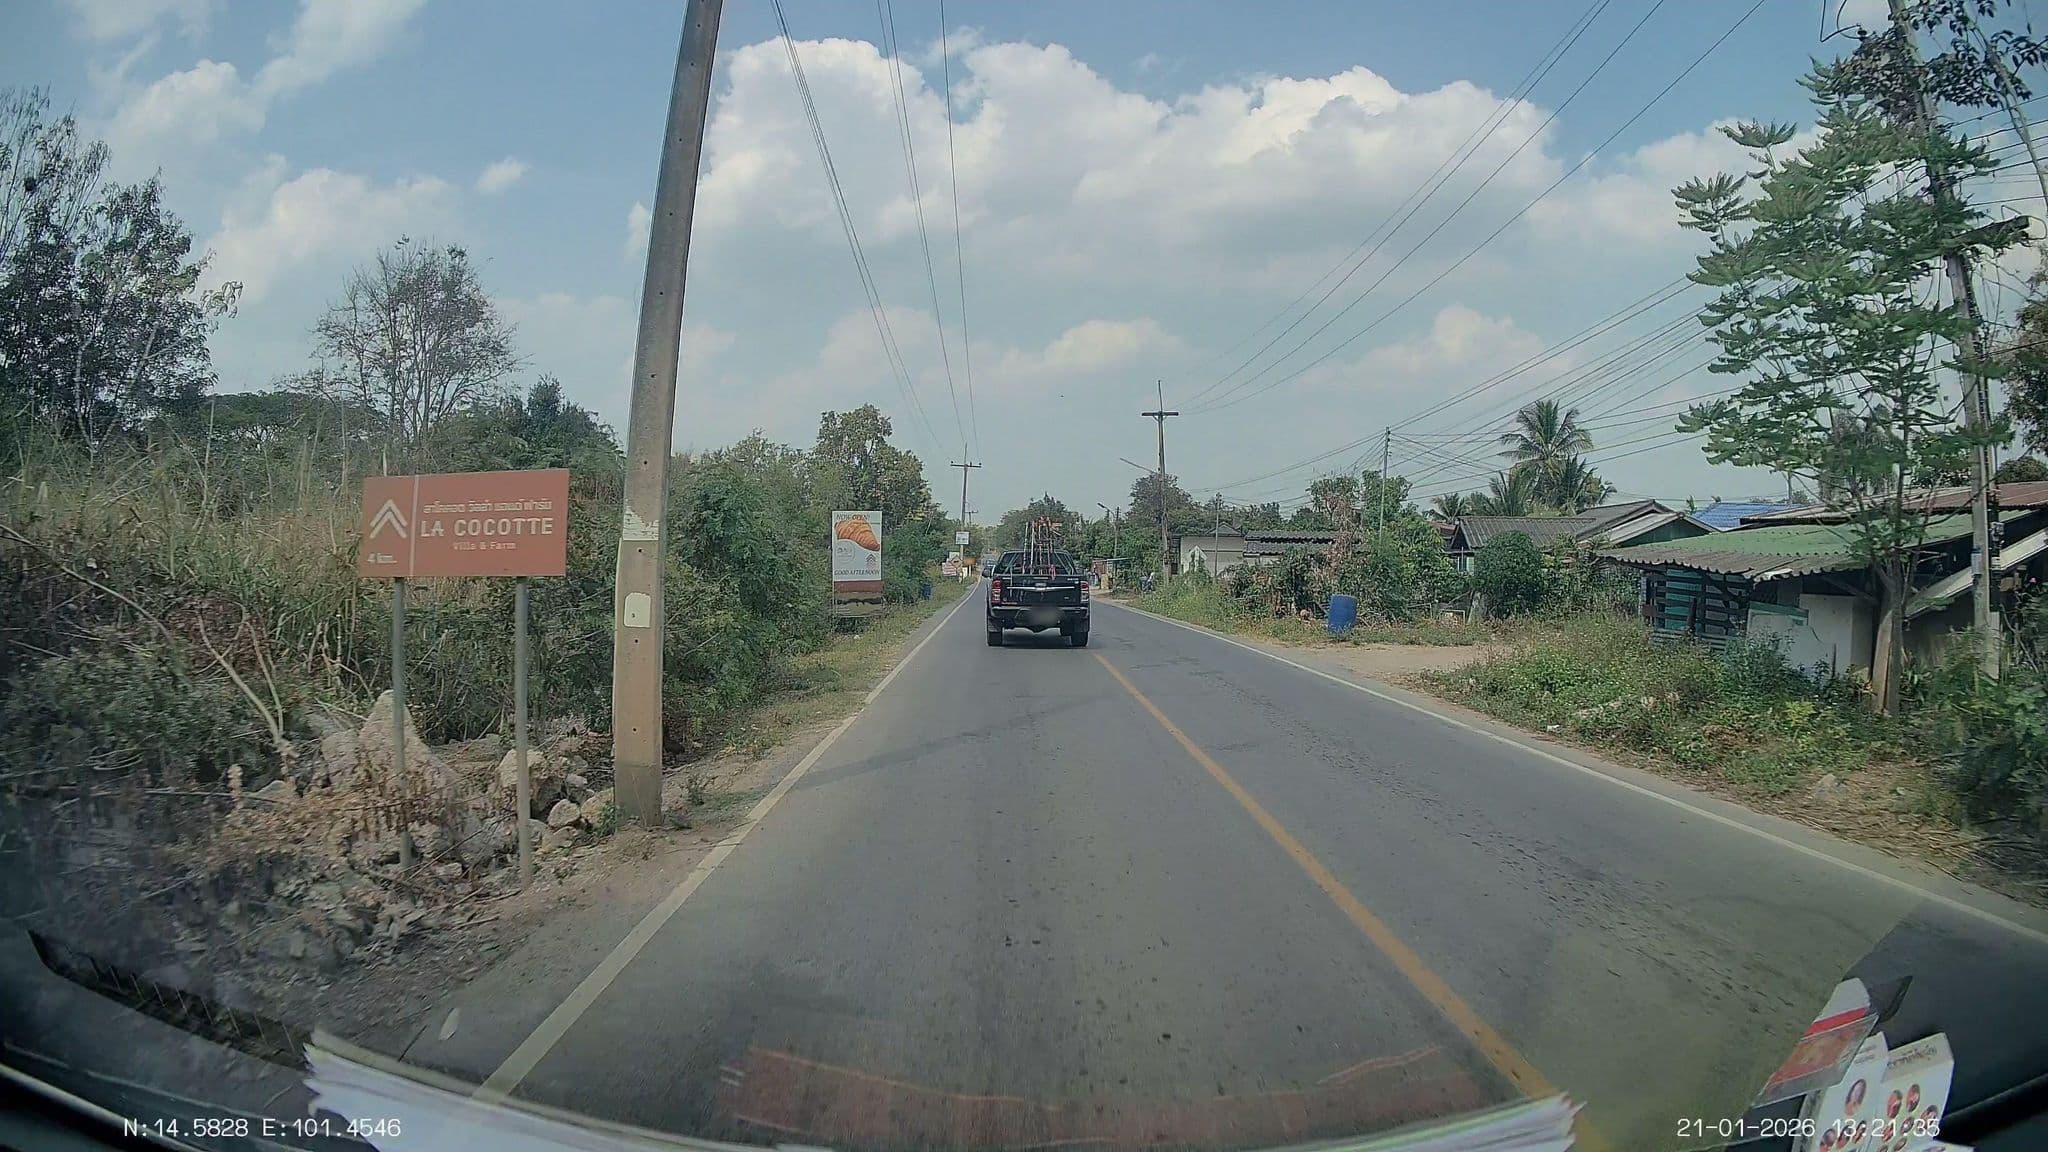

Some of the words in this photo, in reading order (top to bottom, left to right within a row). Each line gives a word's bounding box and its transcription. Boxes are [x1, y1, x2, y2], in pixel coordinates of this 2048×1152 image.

[420, 520, 445, 537] LA
[453, 517, 554, 537] COCOTTE
[453, 541, 476, 551] Villa
[479, 541, 488, 550] &
[490, 540, 517, 550] Farm
